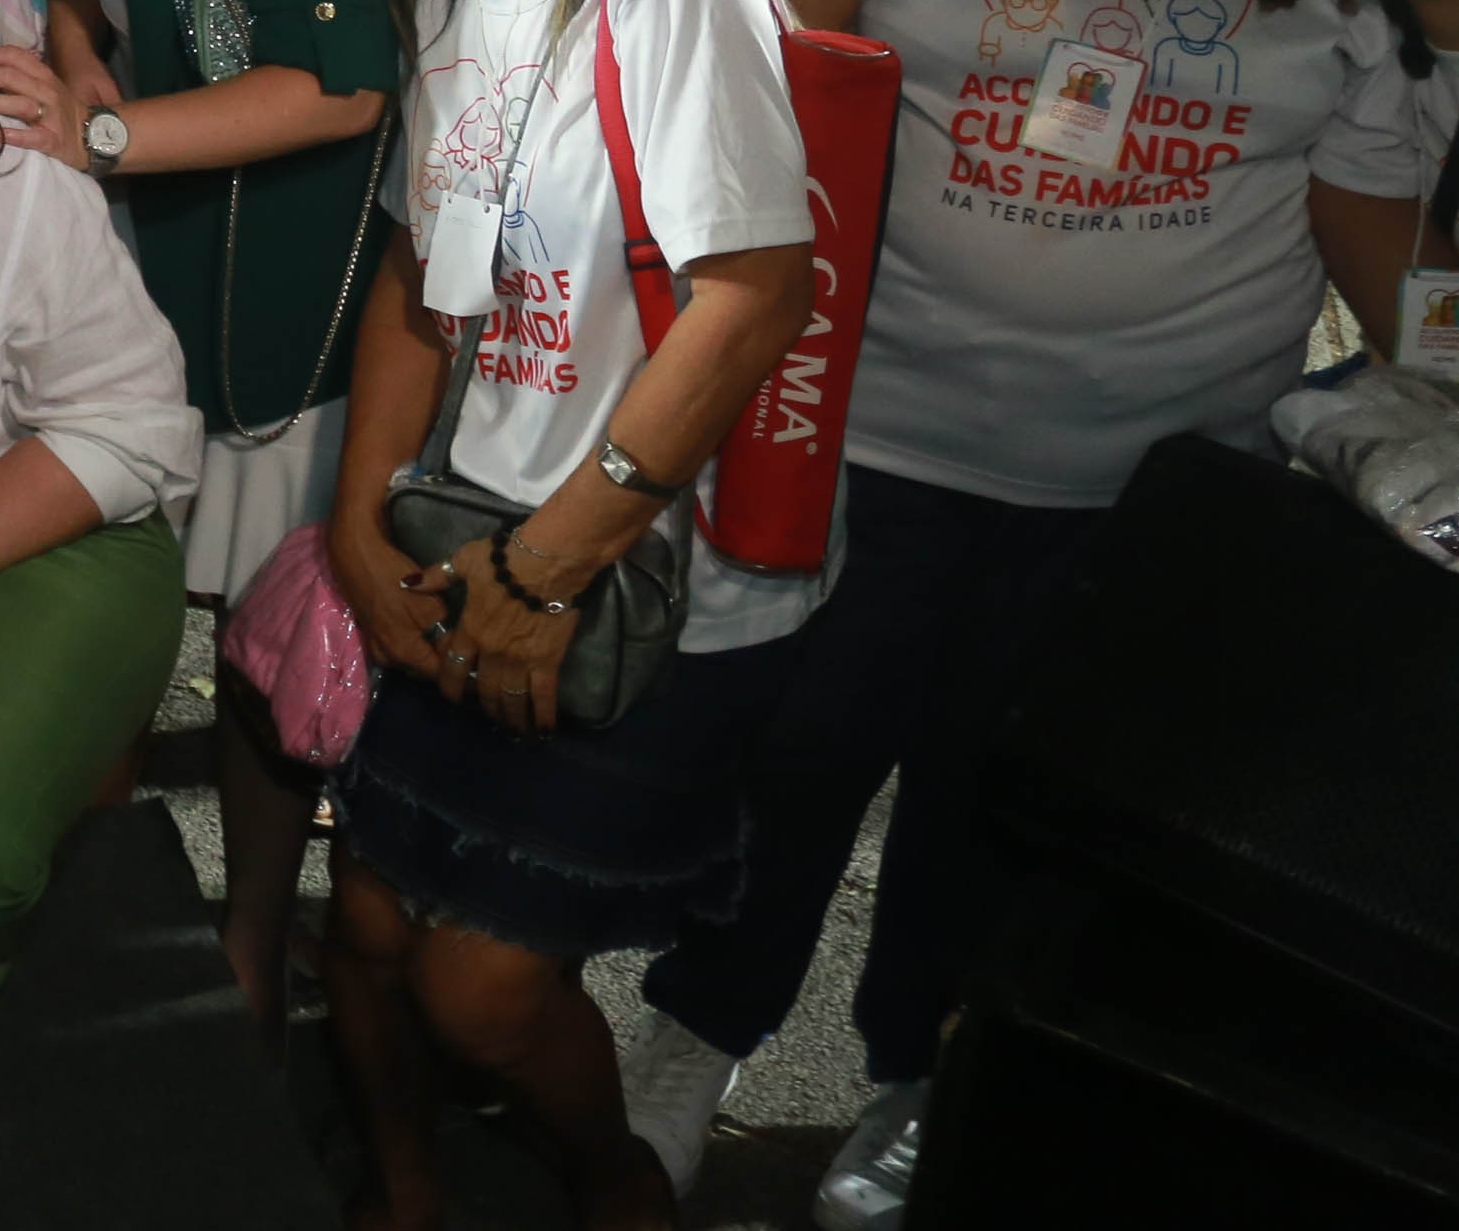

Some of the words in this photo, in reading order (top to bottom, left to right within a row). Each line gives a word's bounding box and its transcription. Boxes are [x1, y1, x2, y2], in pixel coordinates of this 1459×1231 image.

[958, 73, 1213, 130] ACONDO
[1222, 104, 1252, 135] E
[950, 109, 1241, 178] CUNDO
[948, 151, 1025, 196] DAS
[940, 188, 974, 211] NA
[988, 200, 1124, 232] TERCEIRA
[1138, 206, 1211, 230] IDADE
[551, 270, 570, 300] E
